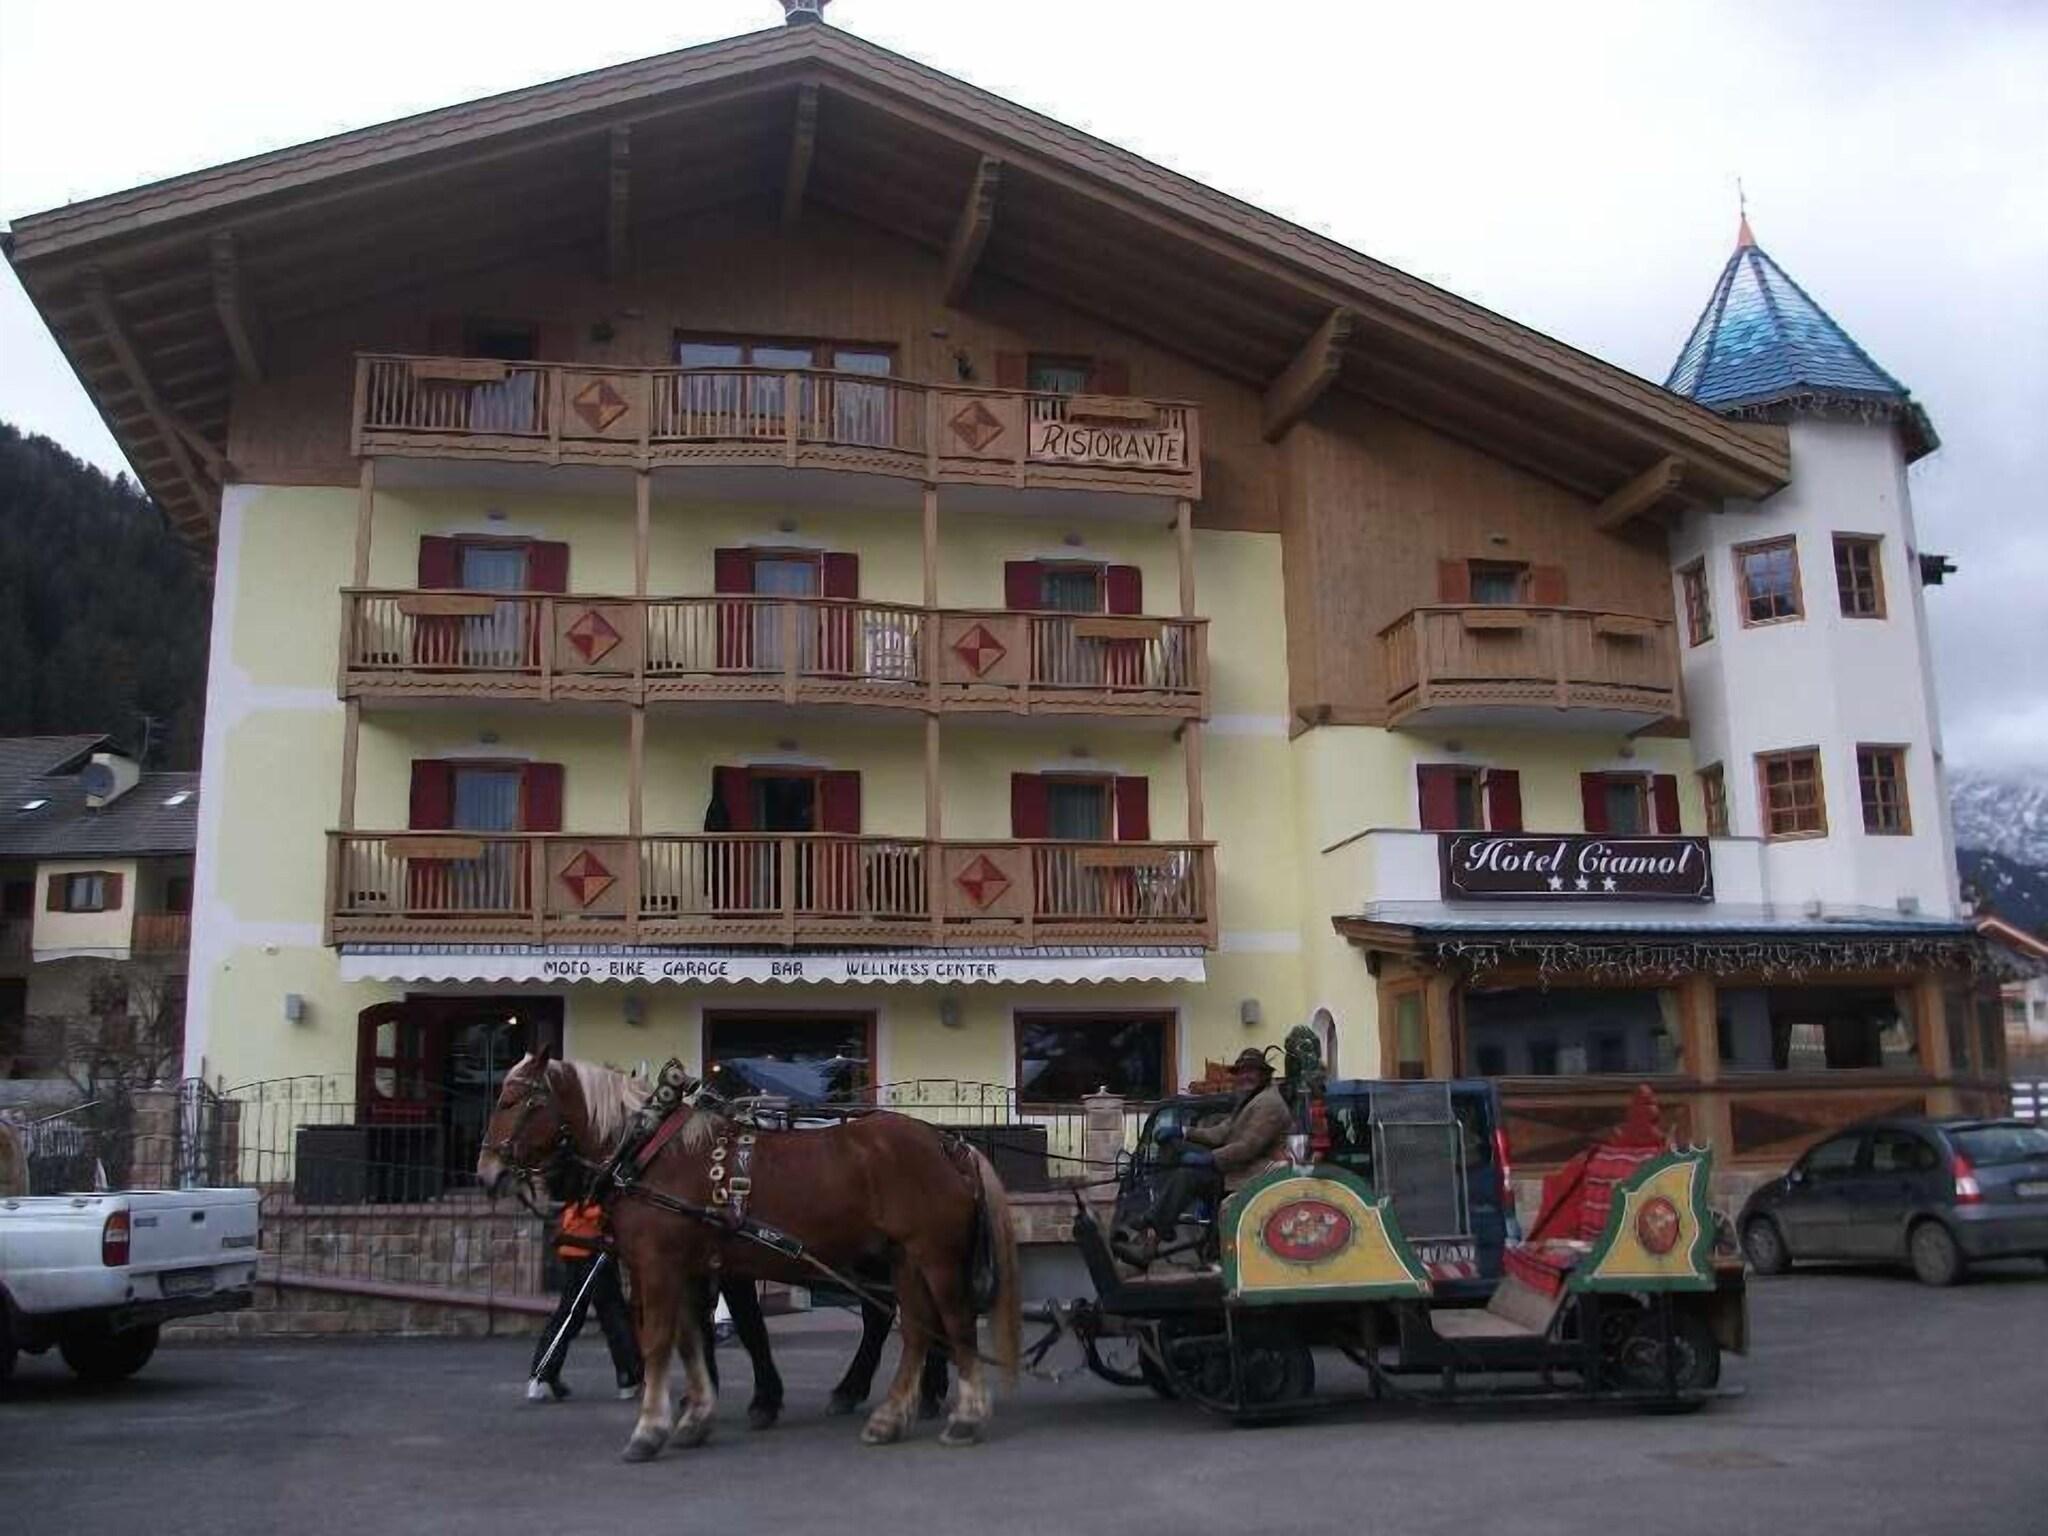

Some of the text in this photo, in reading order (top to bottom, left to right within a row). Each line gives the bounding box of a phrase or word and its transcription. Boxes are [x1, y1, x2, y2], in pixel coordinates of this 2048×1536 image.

[1033, 424, 1179, 462] RISTORANTE
[1464, 839, 1693, 874] Hotel Ciamol
[609, 961, 645, 975] BIKE
[663, 961, 728, 975] GARAGE
[771, 962, 803, 975] BAR
[846, 963, 998, 976] WELLNESS CENTER
